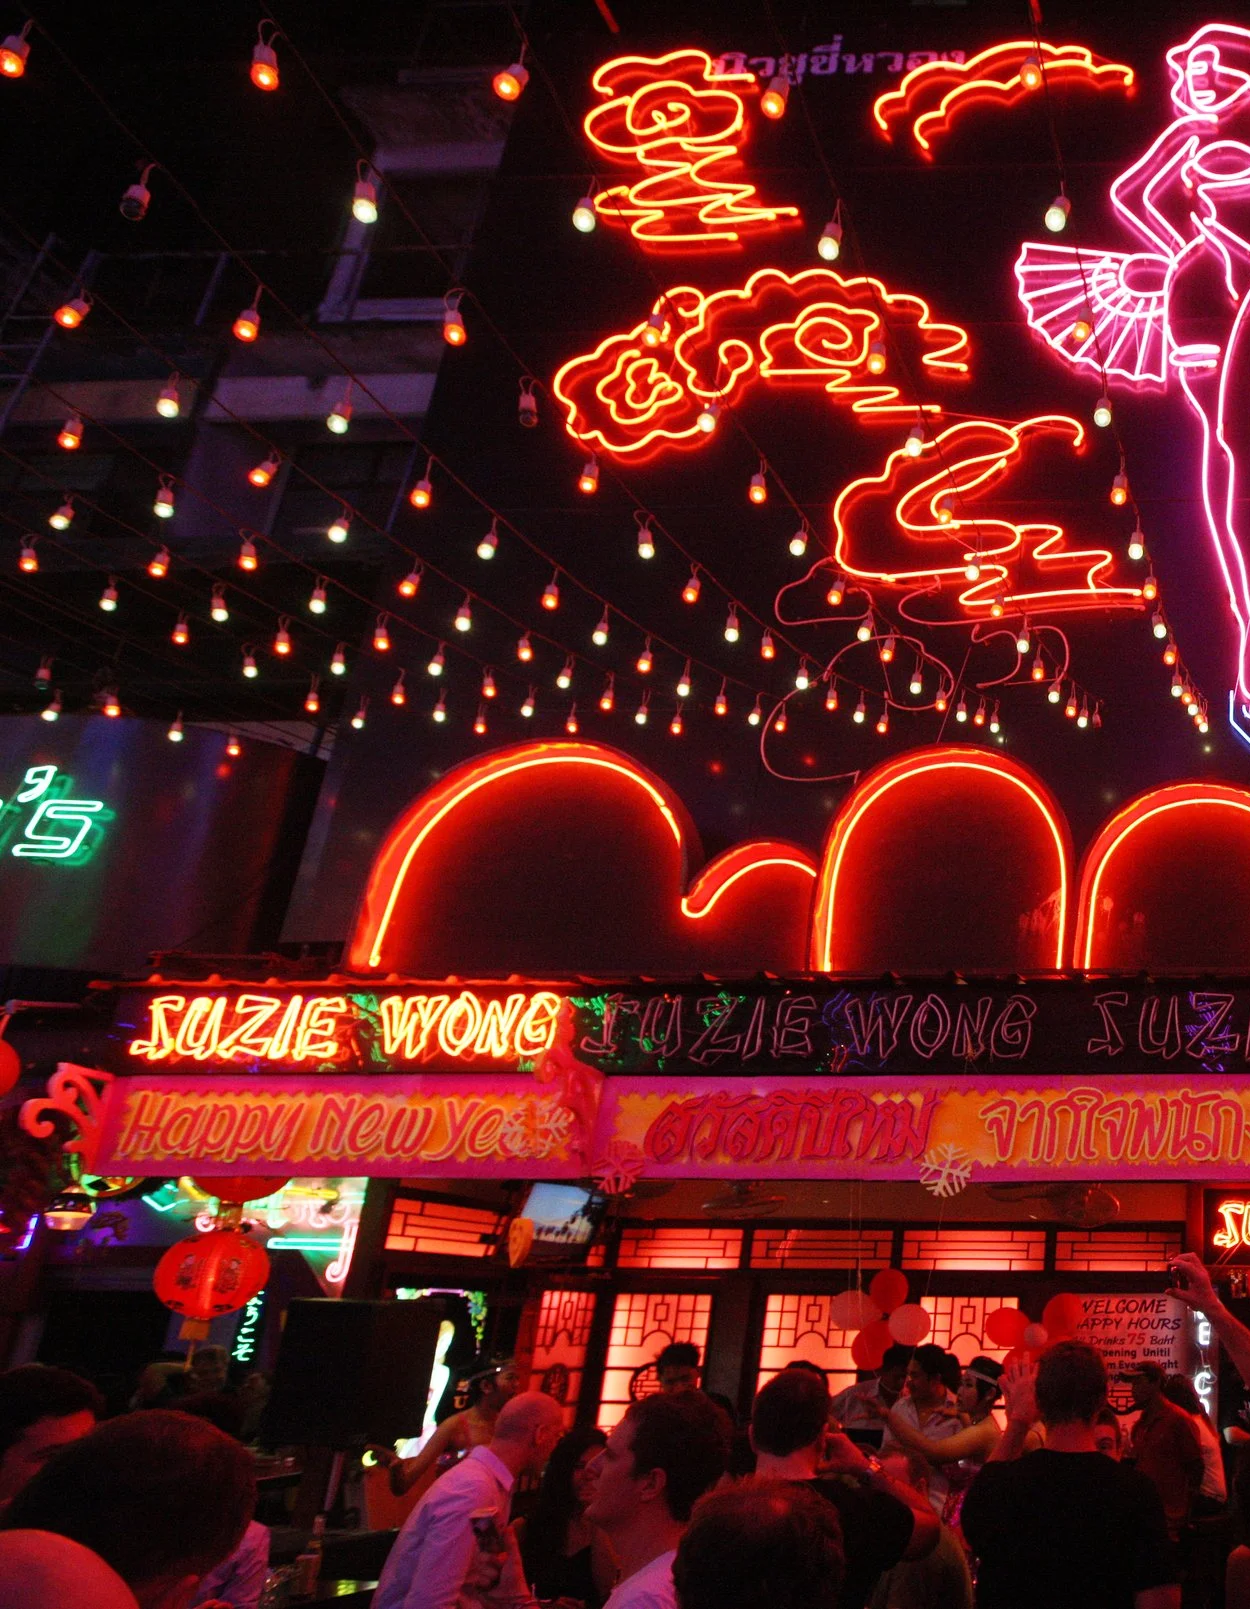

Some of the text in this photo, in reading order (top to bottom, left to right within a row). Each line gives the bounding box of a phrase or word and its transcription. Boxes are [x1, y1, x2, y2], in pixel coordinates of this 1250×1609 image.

[128, 990, 563, 1061] SUZIE WONG
[580, 991, 1038, 1064] SUZIE WONG
[117, 1089, 574, 1164] Happy New Ye
[1077, 1317, 1182, 1331] APPY HOURS
[1089, 1335, 1126, 1345] Drinks
[1127, 1332, 1146, 1345] 75
[1149, 1335, 1176, 1345] Baht
